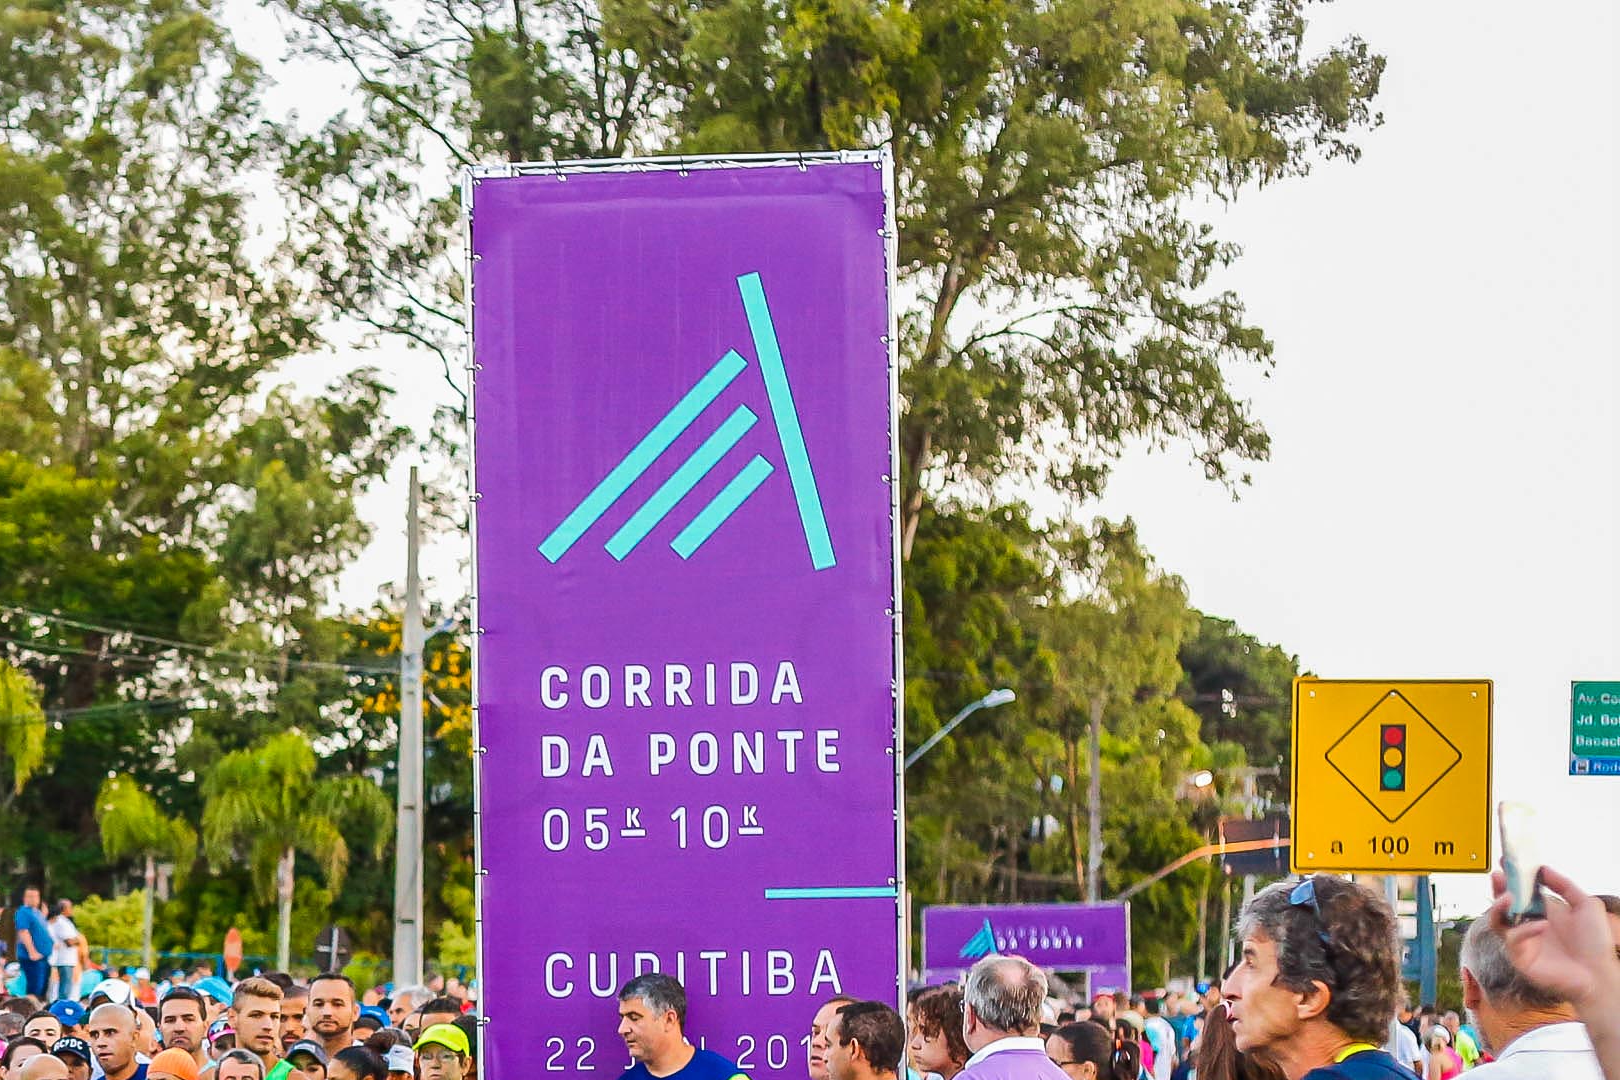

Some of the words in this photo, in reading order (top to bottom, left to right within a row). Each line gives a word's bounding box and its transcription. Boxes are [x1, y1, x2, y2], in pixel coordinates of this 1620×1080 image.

[540, 660, 804, 710] CORRIDA
[541, 734, 615, 778] DA
[649, 729, 841, 776] PONTE
[1331, 841, 1343, 855] a
[1368, 836, 1409, 855] 100
[1434, 841, 1455, 856] m
[545, 1036, 596, 1071] 22
[736, 1033, 810, 1069] 201
